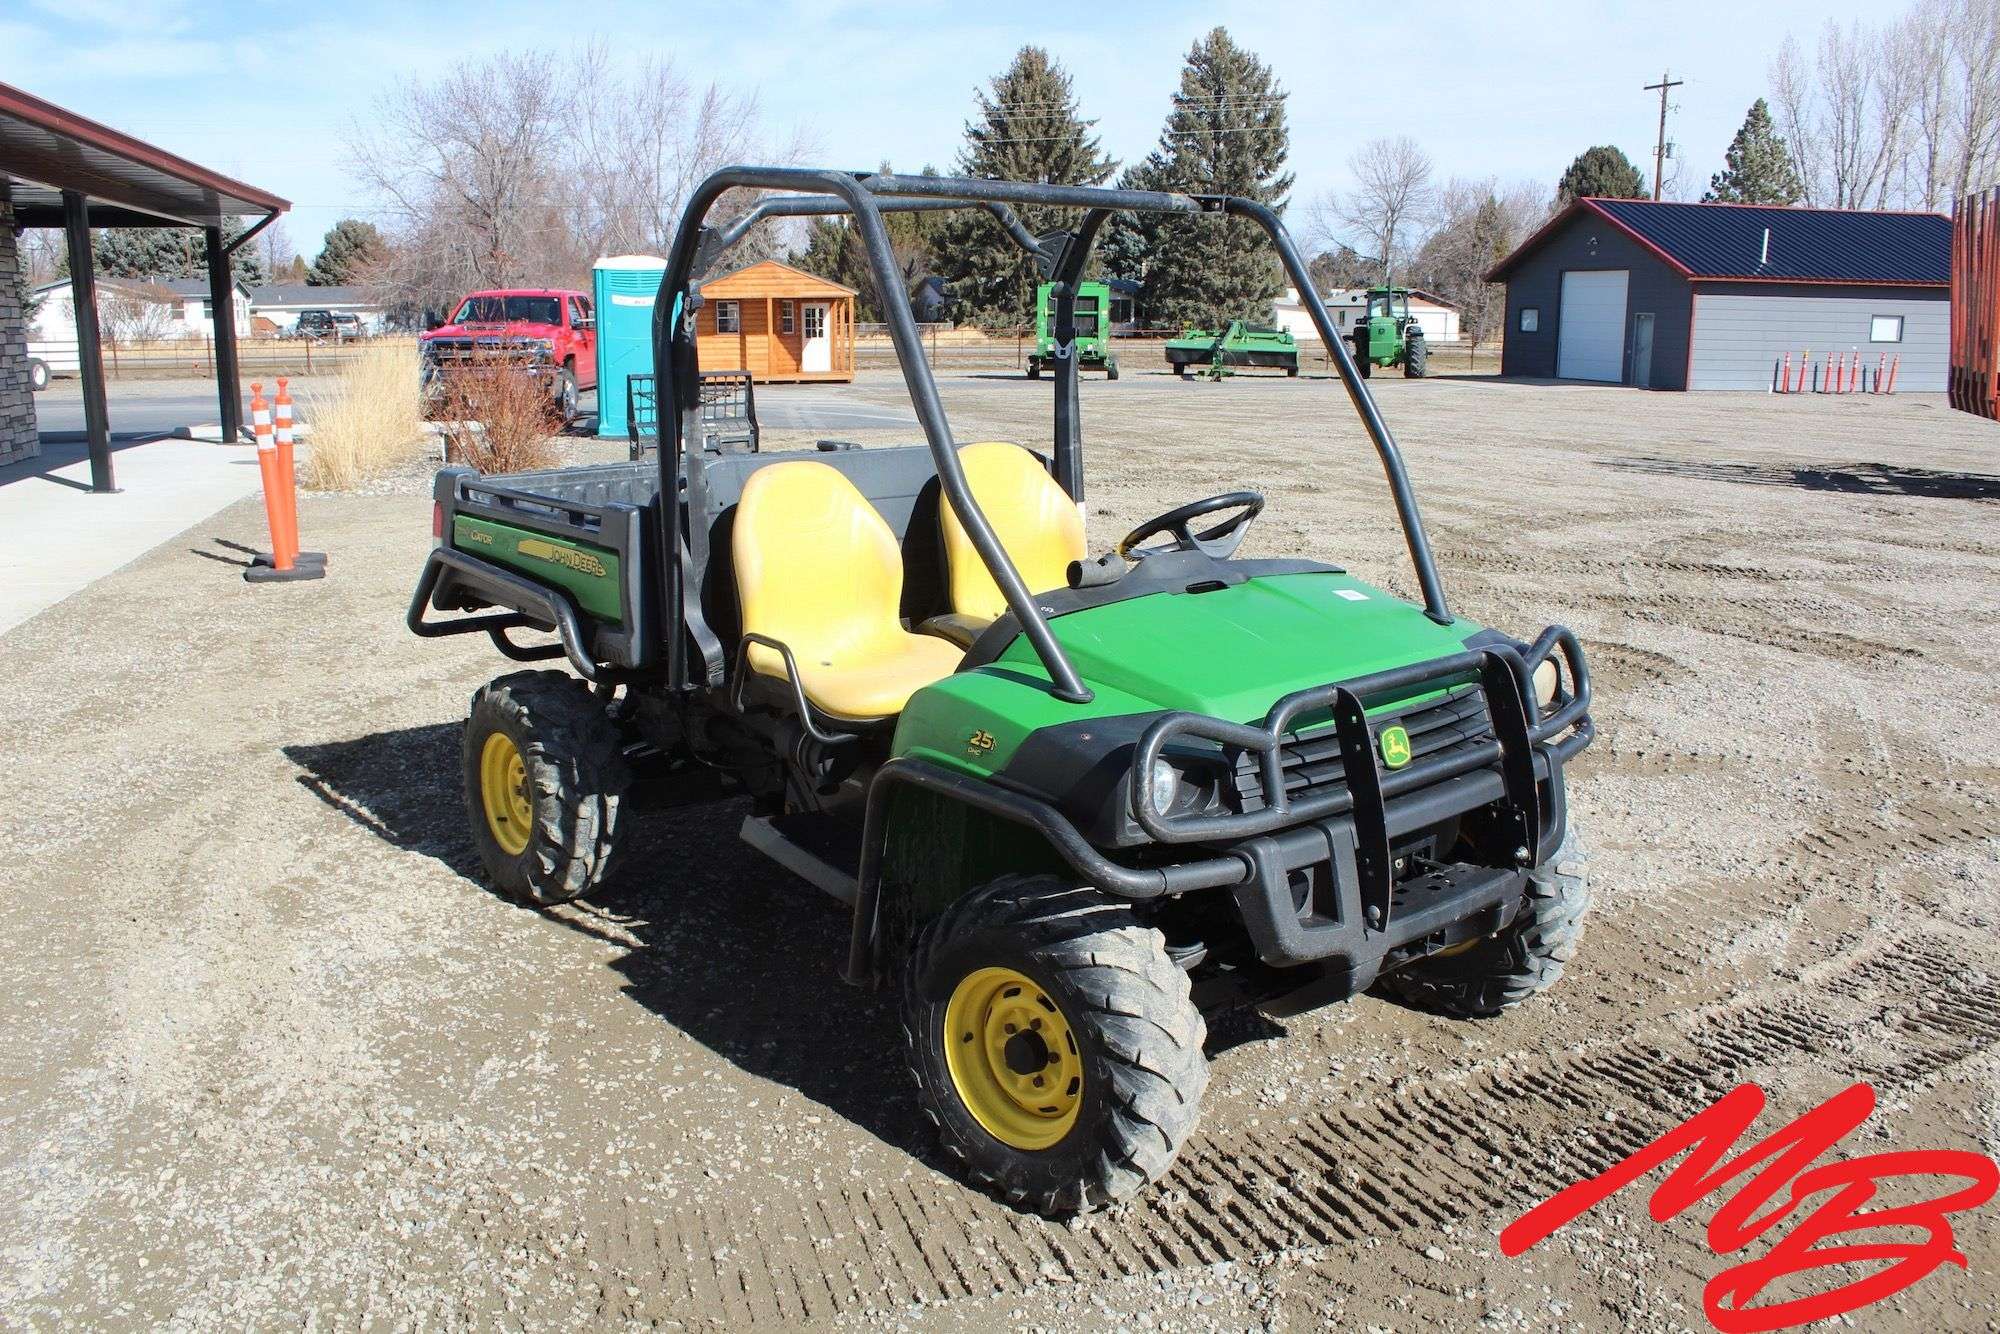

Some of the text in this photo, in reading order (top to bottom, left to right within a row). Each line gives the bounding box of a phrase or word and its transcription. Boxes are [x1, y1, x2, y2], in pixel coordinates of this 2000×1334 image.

[471, 531, 493, 545] GATOR
[550, 547, 606, 577] JOHN DEERE
